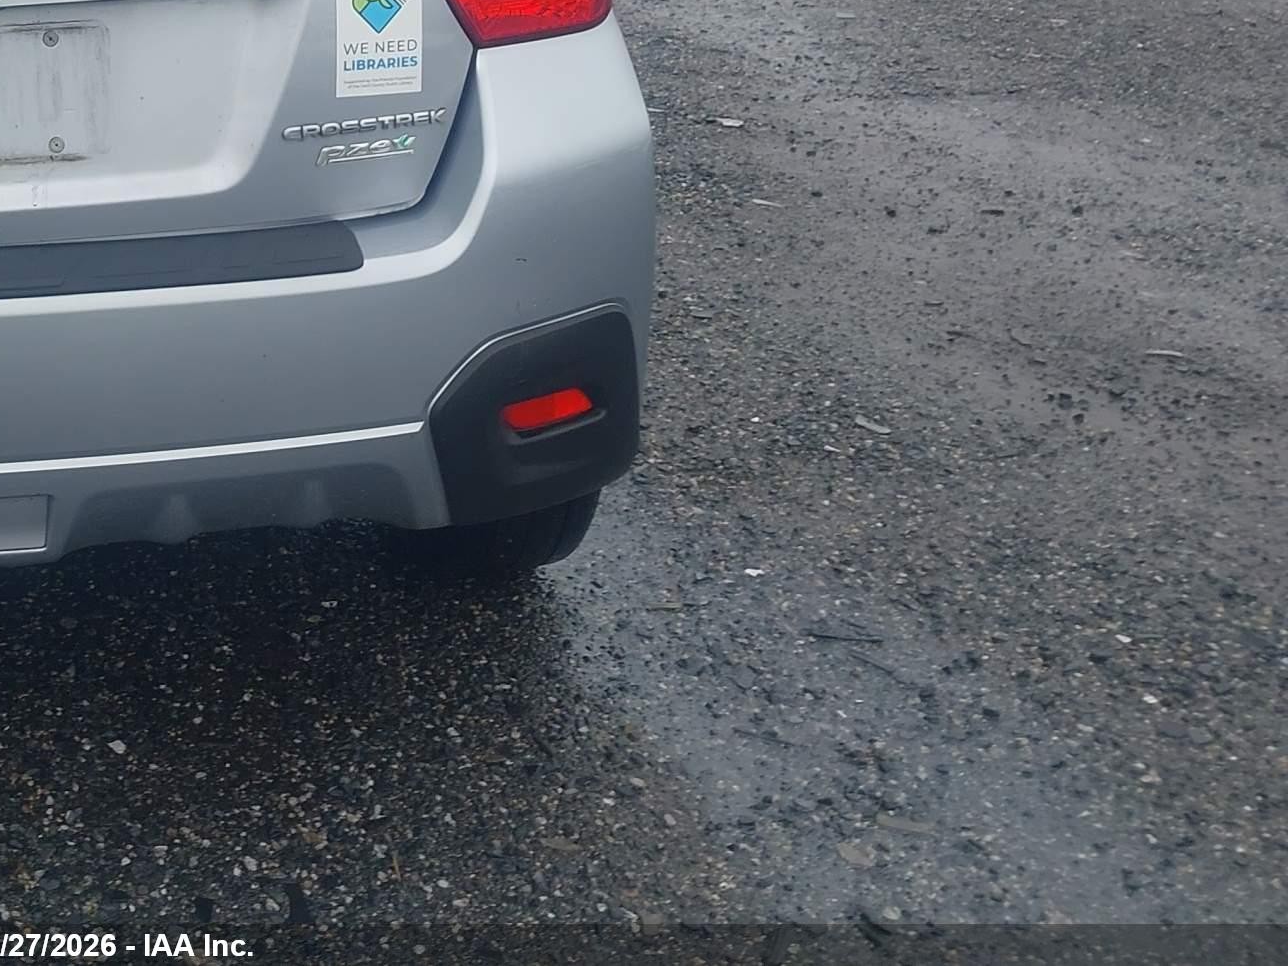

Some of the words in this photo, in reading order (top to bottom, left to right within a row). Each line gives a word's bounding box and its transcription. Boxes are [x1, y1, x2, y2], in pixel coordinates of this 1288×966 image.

[343, 42, 369, 55] WE
[375, 39, 418, 53] NEED
[343, 56, 418, 71] LIBRARIES
[282, 107, 447, 141] CROSSTREK
